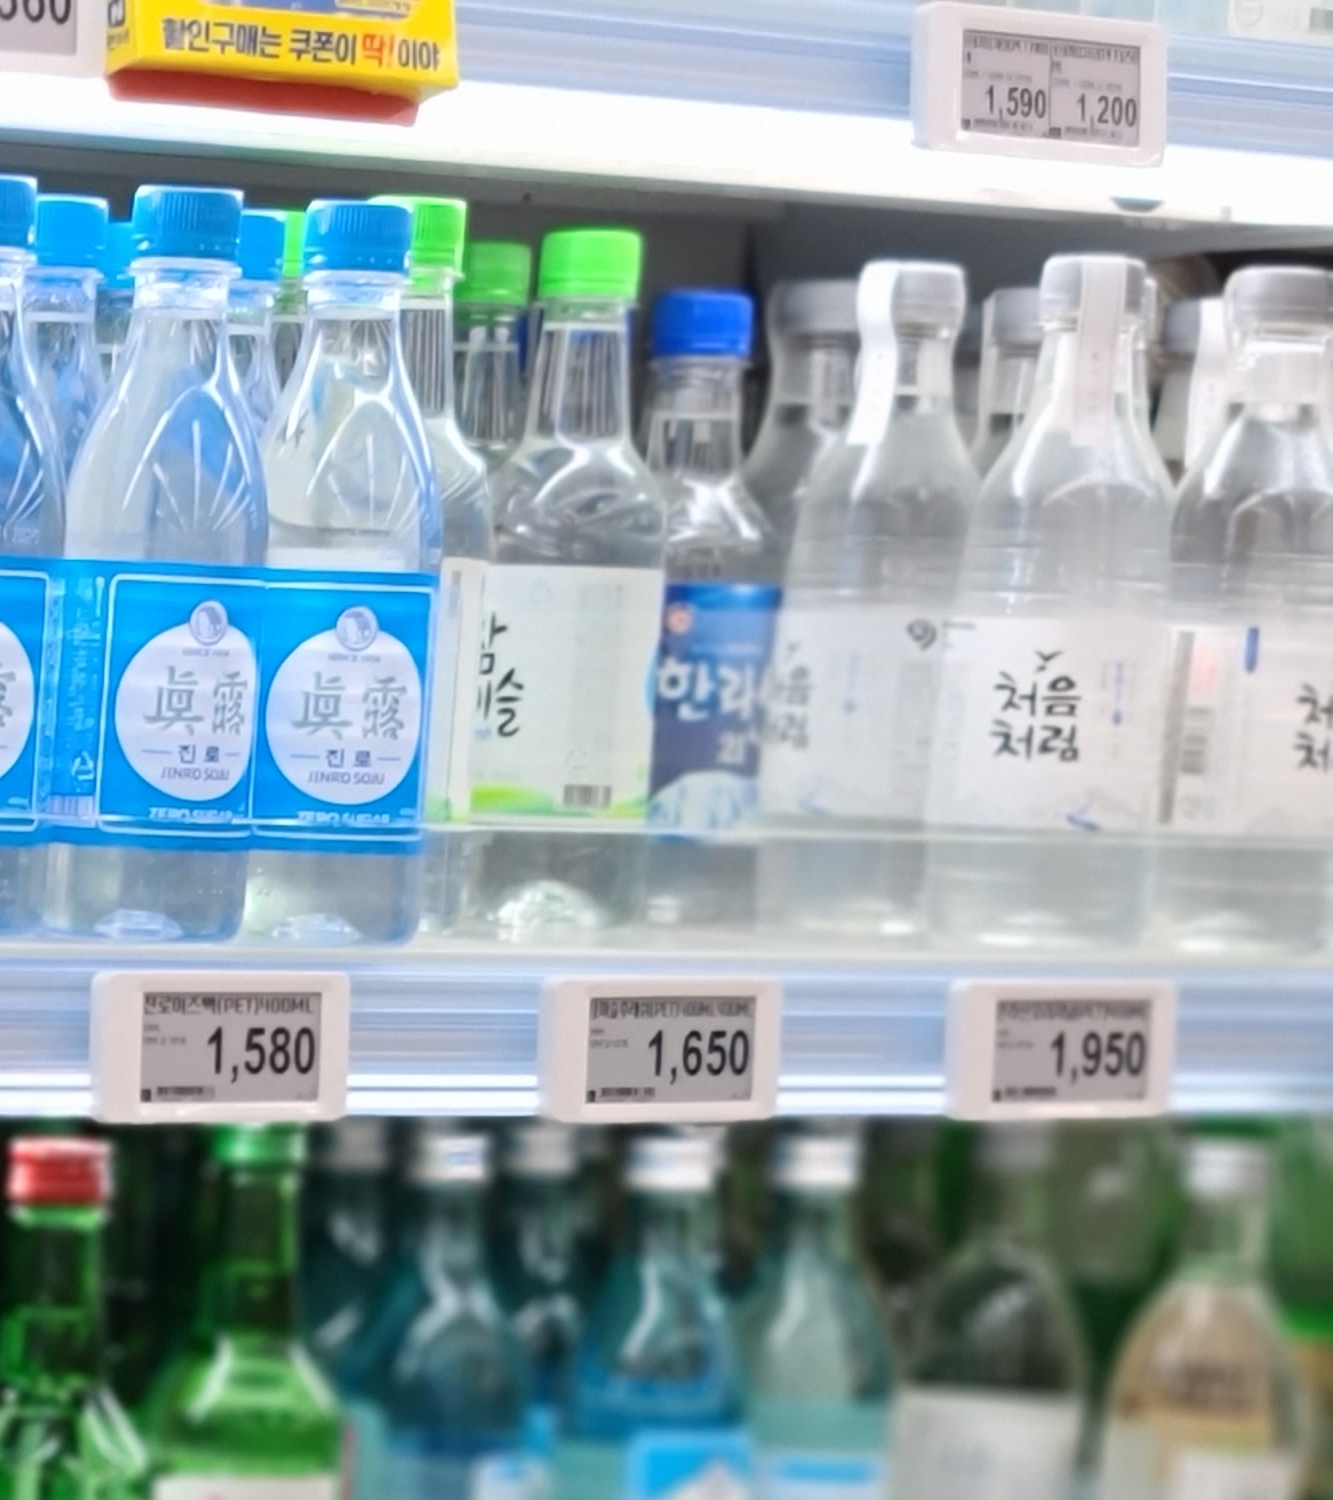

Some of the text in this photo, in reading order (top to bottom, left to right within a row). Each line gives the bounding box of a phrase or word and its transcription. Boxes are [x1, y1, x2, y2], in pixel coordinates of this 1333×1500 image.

[162, 18, 282, 59] 할인구매는
[289, 29, 357, 66] 쿠폰이
[991, 671, 1082, 719] 처음
[178, 745, 220, 763] 진로
[326, 749, 373, 768] 진로
[989, 720, 1082, 764] 처럼
[207, 1026, 316, 1084] 1,580
[648, 1029, 750, 1085] 1,650
[1051, 1031, 1147, 1084] 1,950
